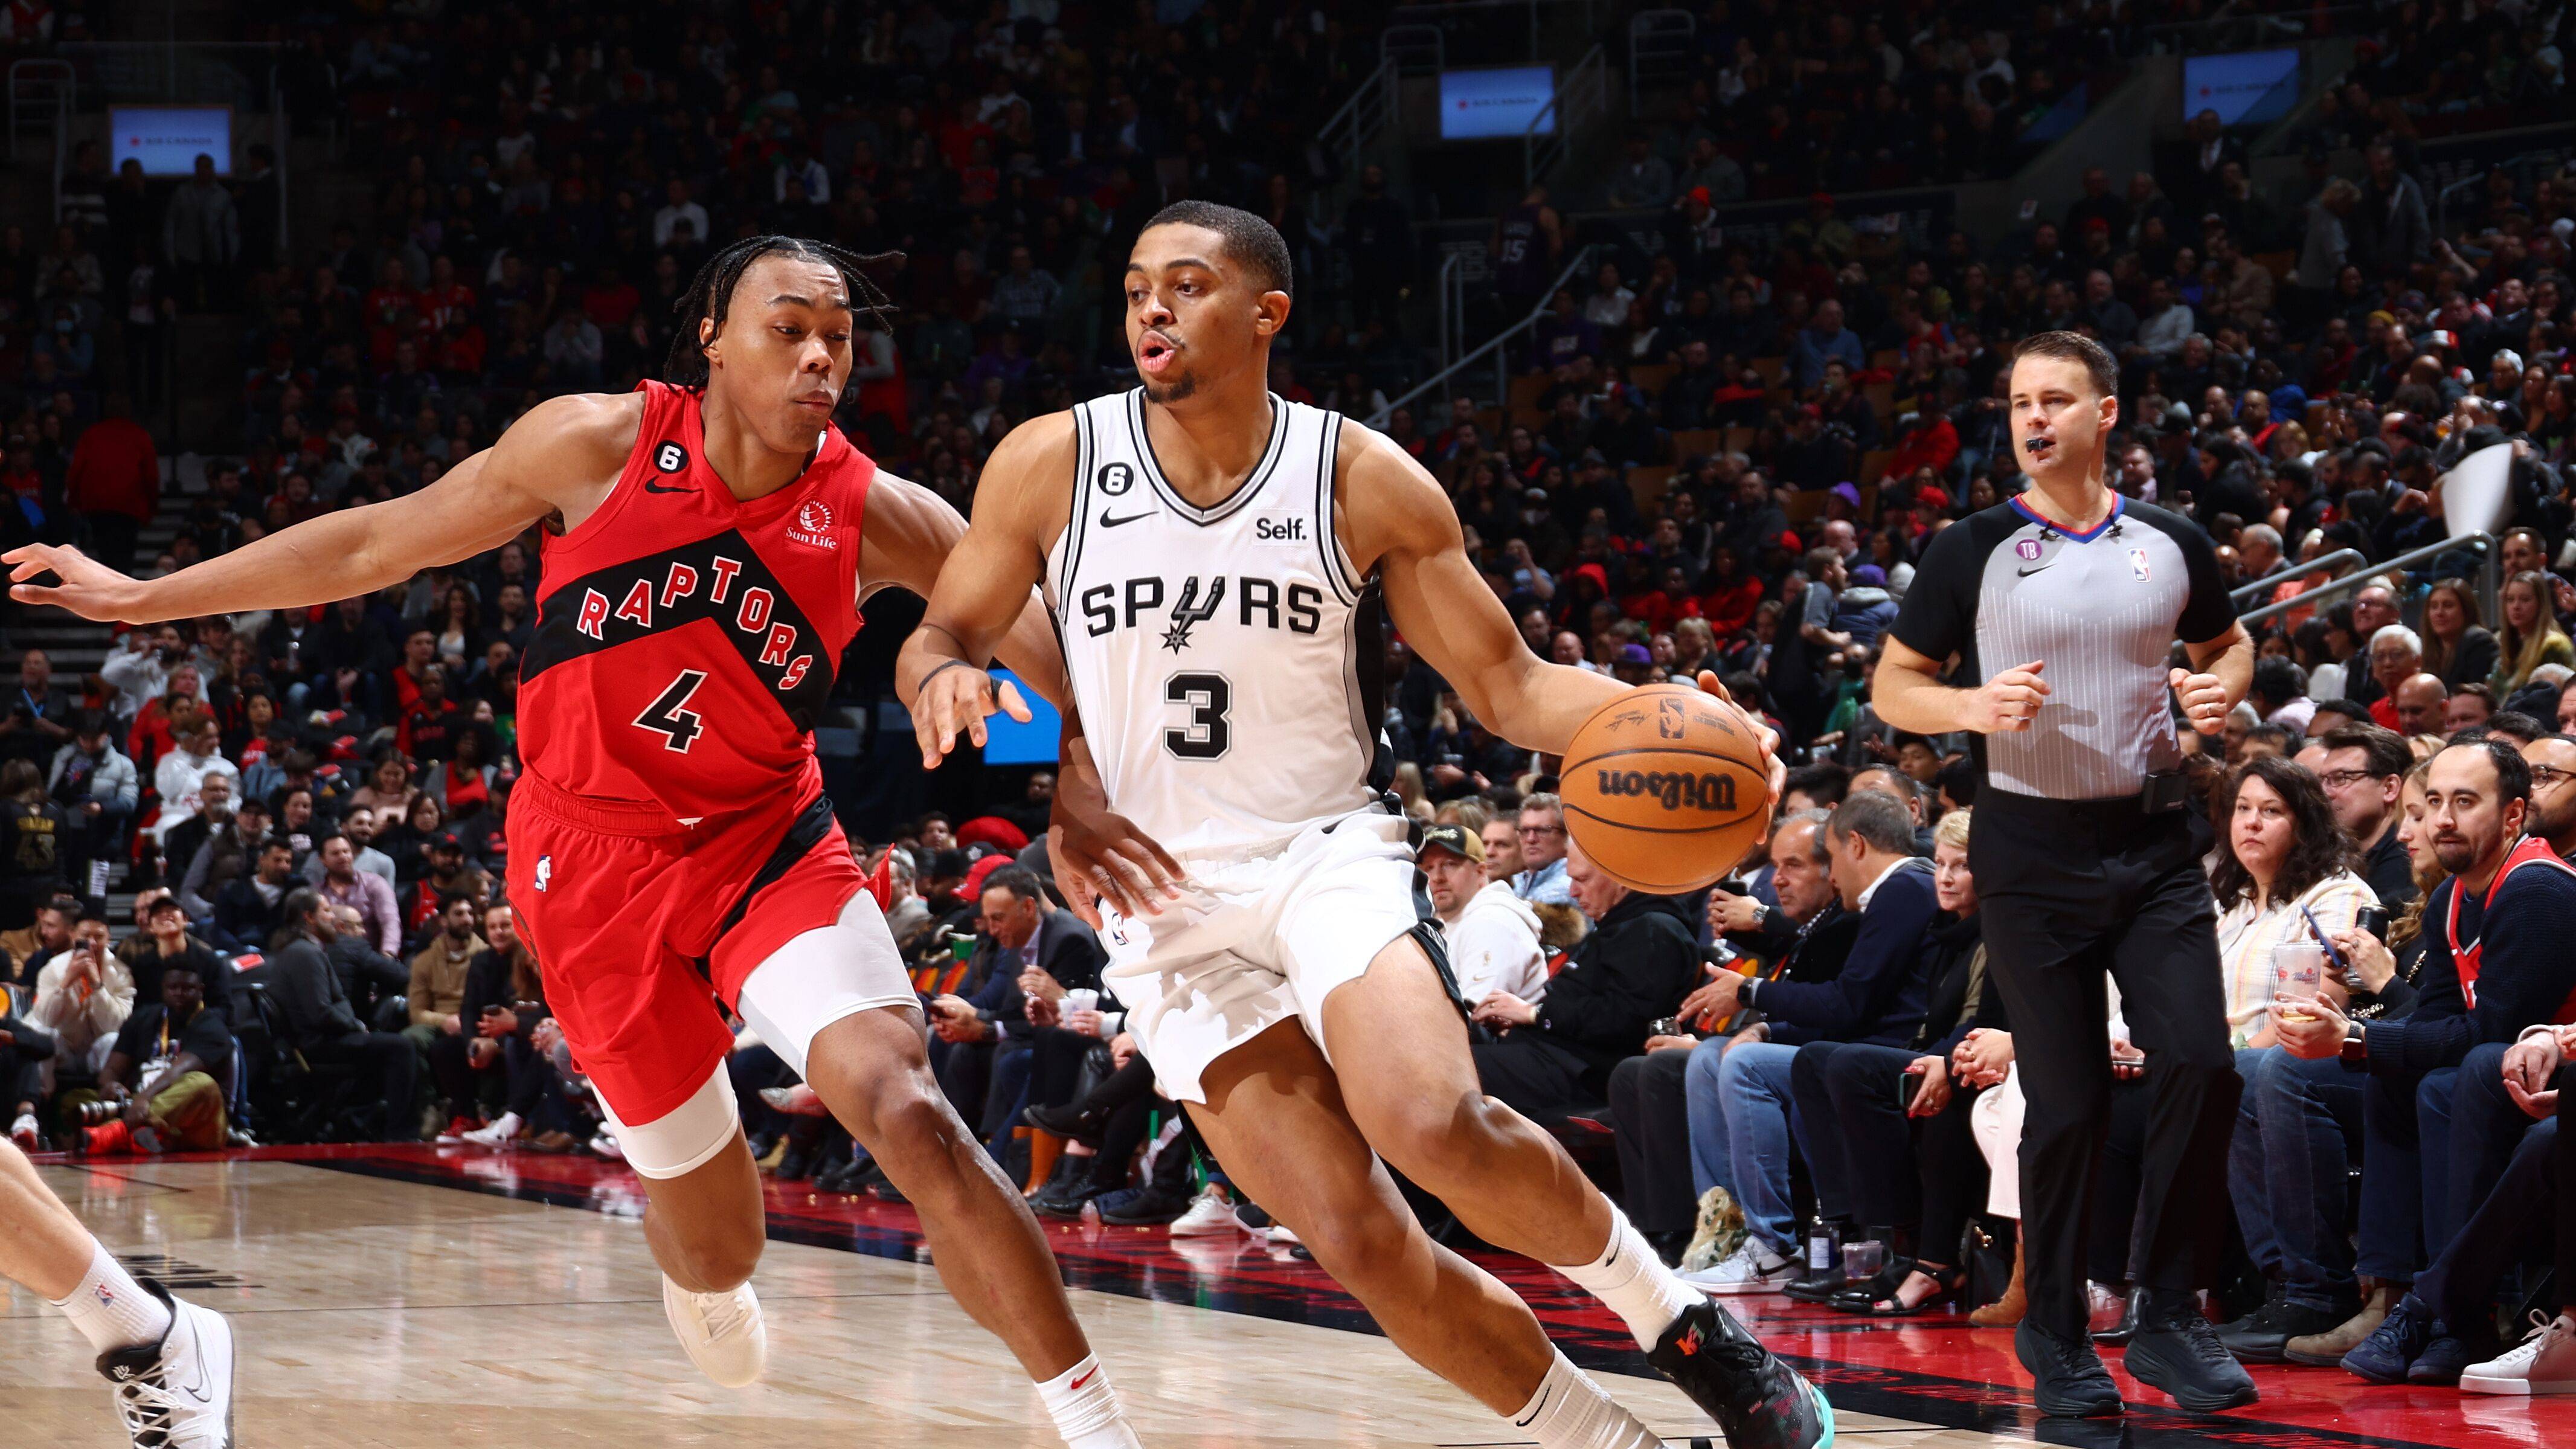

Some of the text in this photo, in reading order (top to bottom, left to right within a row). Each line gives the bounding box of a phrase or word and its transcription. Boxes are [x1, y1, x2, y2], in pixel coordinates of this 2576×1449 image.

[659, 445, 681, 471] 6
[1105, 466, 1126, 492] 6
[786, 526, 837, 550] Sun Life
[1256, 517, 1307, 540] Self.
[2020, 542, 2037, 559] TB
[577, 555, 812, 690] RAPTORS
[1081, 576, 1323, 656] SPURS
[631, 669, 708, 754] 4
[1163, 670, 1233, 762] 3
[1598, 769, 1738, 811] Wilson
